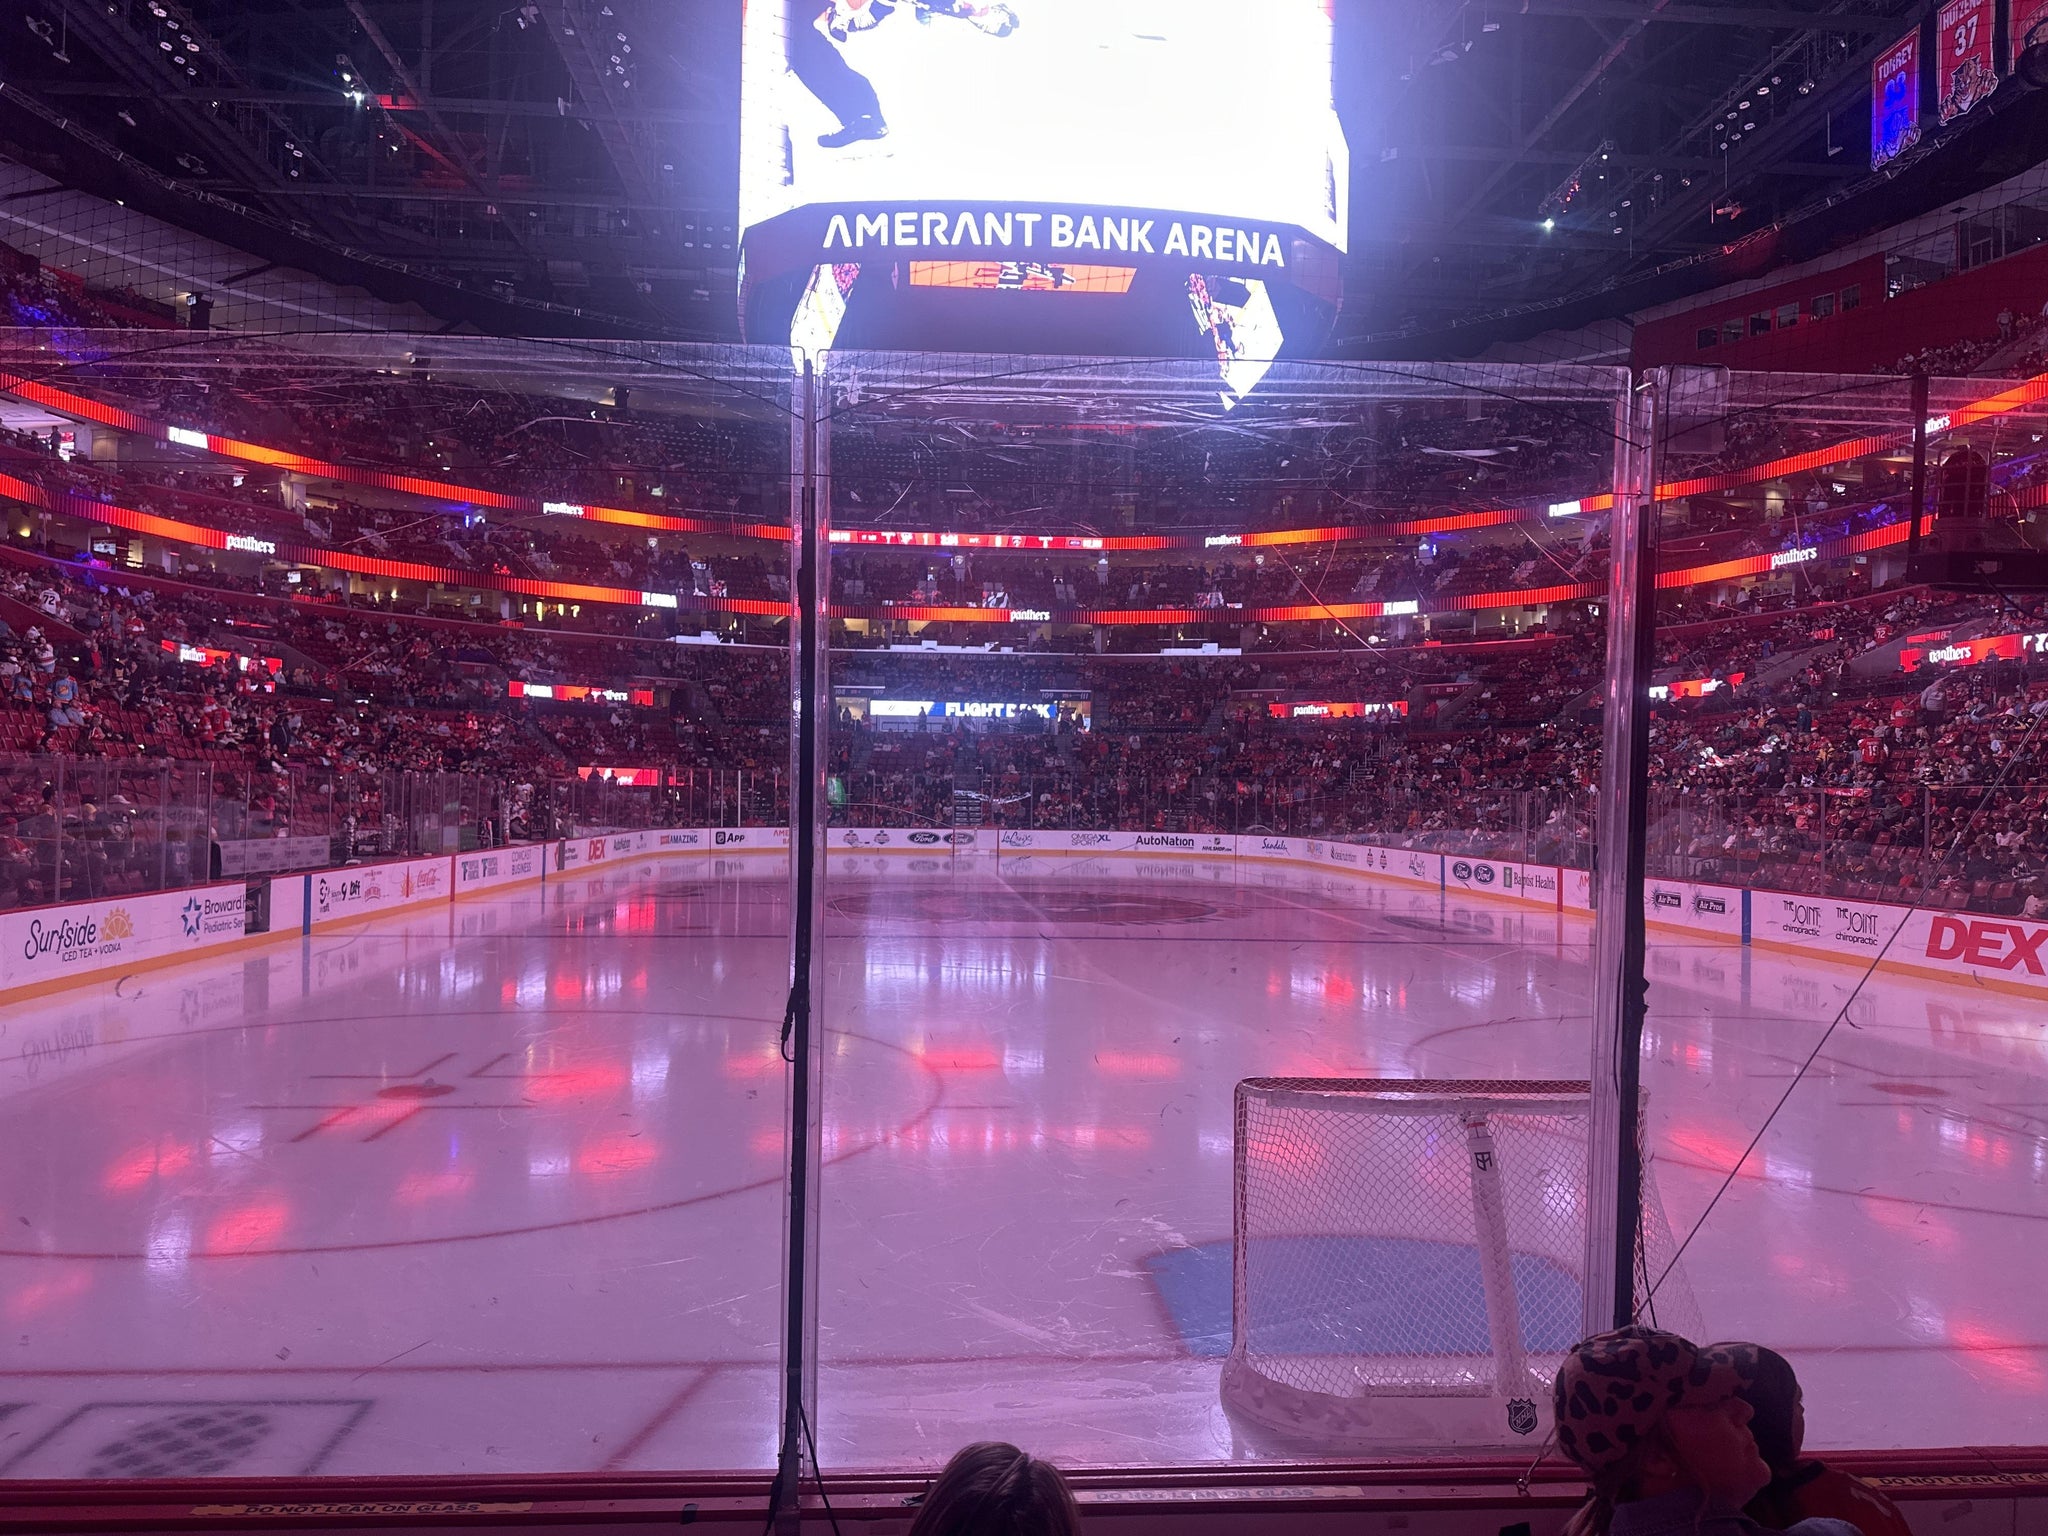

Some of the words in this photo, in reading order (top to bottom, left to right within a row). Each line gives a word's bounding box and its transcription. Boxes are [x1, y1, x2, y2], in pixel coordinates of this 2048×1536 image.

[1955, 14, 1979, 57] 37
[1878, 42, 1912, 82] TORREY
[823, 212, 1042, 248] AMERANT
[1051, 214, 1155, 254] BANK
[1163, 222, 1286, 268] ARENA
[543, 502, 584, 517] panthers
[226, 534, 276, 554] panthers
[1205, 534, 1242, 547] panthers
[1771, 548, 1818, 570] panthers
[43, 595, 56, 606] 72
[1010, 608, 1050, 622] panthers
[946, 702, 1004, 717] FLIGHT
[1293, 704, 1328, 717] panthers
[669, 834, 699, 844] AMAZING
[1136, 835, 1194, 847] AutoNation
[588, 839, 606, 860] DEX
[511, 862, 531, 876] BUSINESS
[1535, 874, 1555, 890] Health
[204, 896, 242, 915] Broward
[1658, 895, 1666, 903] Air
[1666, 896, 1678, 905] Pros
[1699, 900, 1708, 910] Air
[1709, 902, 1722, 911] Pros
[1783, 900, 1794, 911] THE
[1793, 905, 1820, 926] JOINT
[204, 918, 230, 934] Pediatric
[1836, 907, 1848, 919] THE
[1847, 912, 1878, 935] JOINT
[25, 915, 97, 960] Surfside
[1783, 924, 1820, 937] chiropractic
[1835, 932, 1878, 946] chiropractic
[1925, 916, 2048, 976] DEX
[62, 950, 77, 962] ICED
[79, 949, 93, 961] TEA
[100, 943, 121, 954] VODKA
[1880, 1478, 1904, 1486] DO
[1909, 1477, 1945, 1485] NOT
[1951, 1475, 1994, 1484] LEAN
[1255, 1488, 1314, 1497] GLASS
[245, 1506, 274, 1514] DO
[279, 1505, 321, 1513] NOT
[325, 1505, 376, 1513] LEAN
[381, 1504, 411, 1512] ON
[416, 1504, 480, 1512] GLASS
